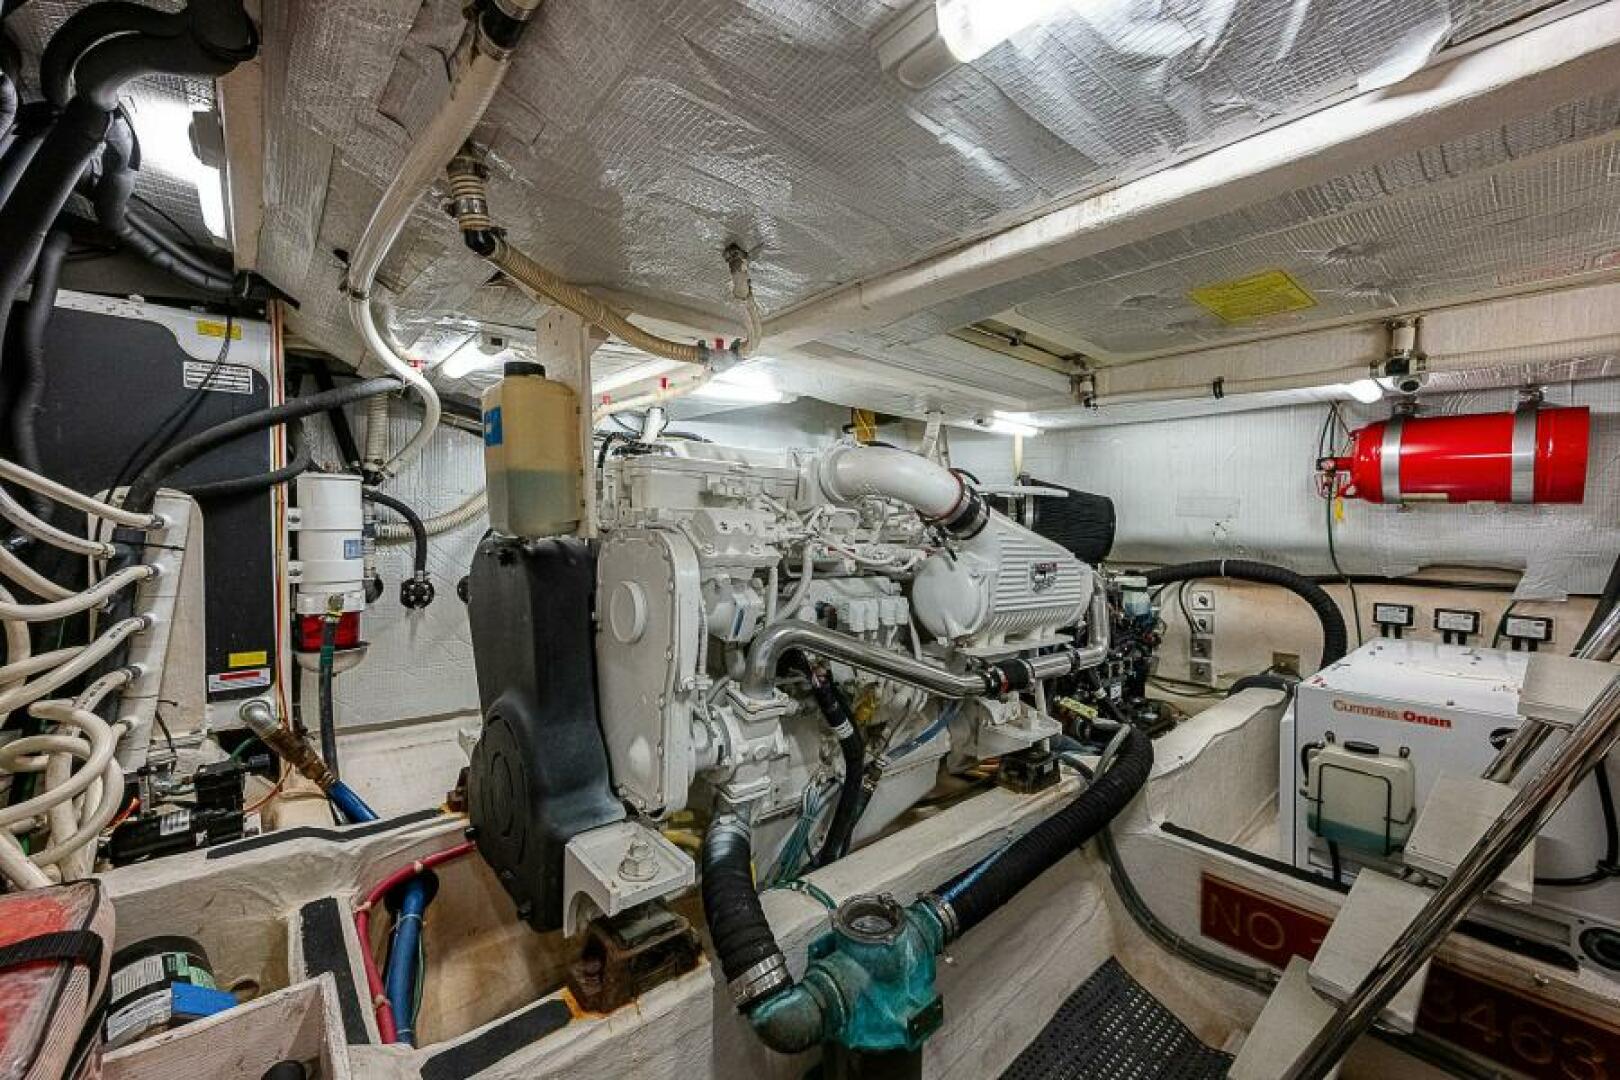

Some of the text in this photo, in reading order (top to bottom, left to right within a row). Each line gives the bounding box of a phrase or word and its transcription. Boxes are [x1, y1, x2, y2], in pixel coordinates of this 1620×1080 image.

[1333, 699, 1452, 729] Cummins Onan
[1209, 892, 1286, 950] NO
